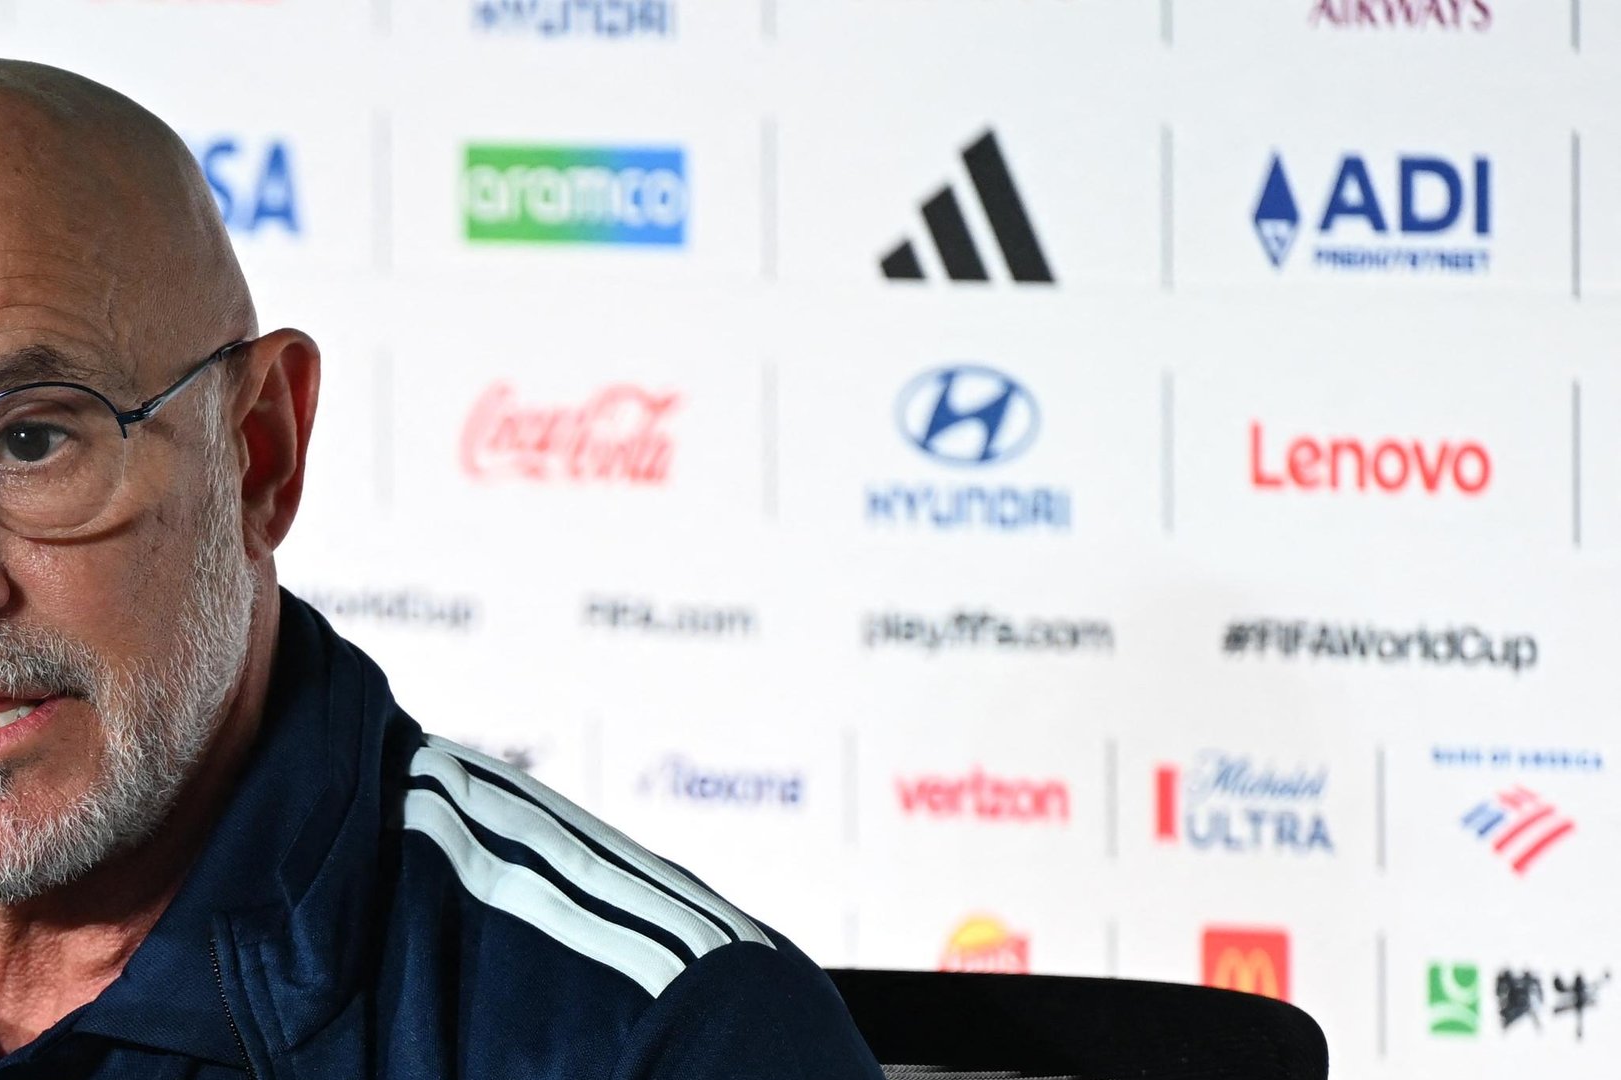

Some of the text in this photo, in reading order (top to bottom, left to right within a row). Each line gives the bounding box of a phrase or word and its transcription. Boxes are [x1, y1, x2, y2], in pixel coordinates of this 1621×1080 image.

[203, 138, 301, 234] SA
[466, 163, 682, 227] aramco
[1318, 155, 1490, 235] ADI
[1250, 422, 1492, 496] Lenovo
[866, 486, 1072, 530] HYUNDAI
[1221, 617, 1539, 673] #FIFAWorldCup
[896, 767, 1071, 823] verizon
[1186, 809, 1335, 854] ULTRA
